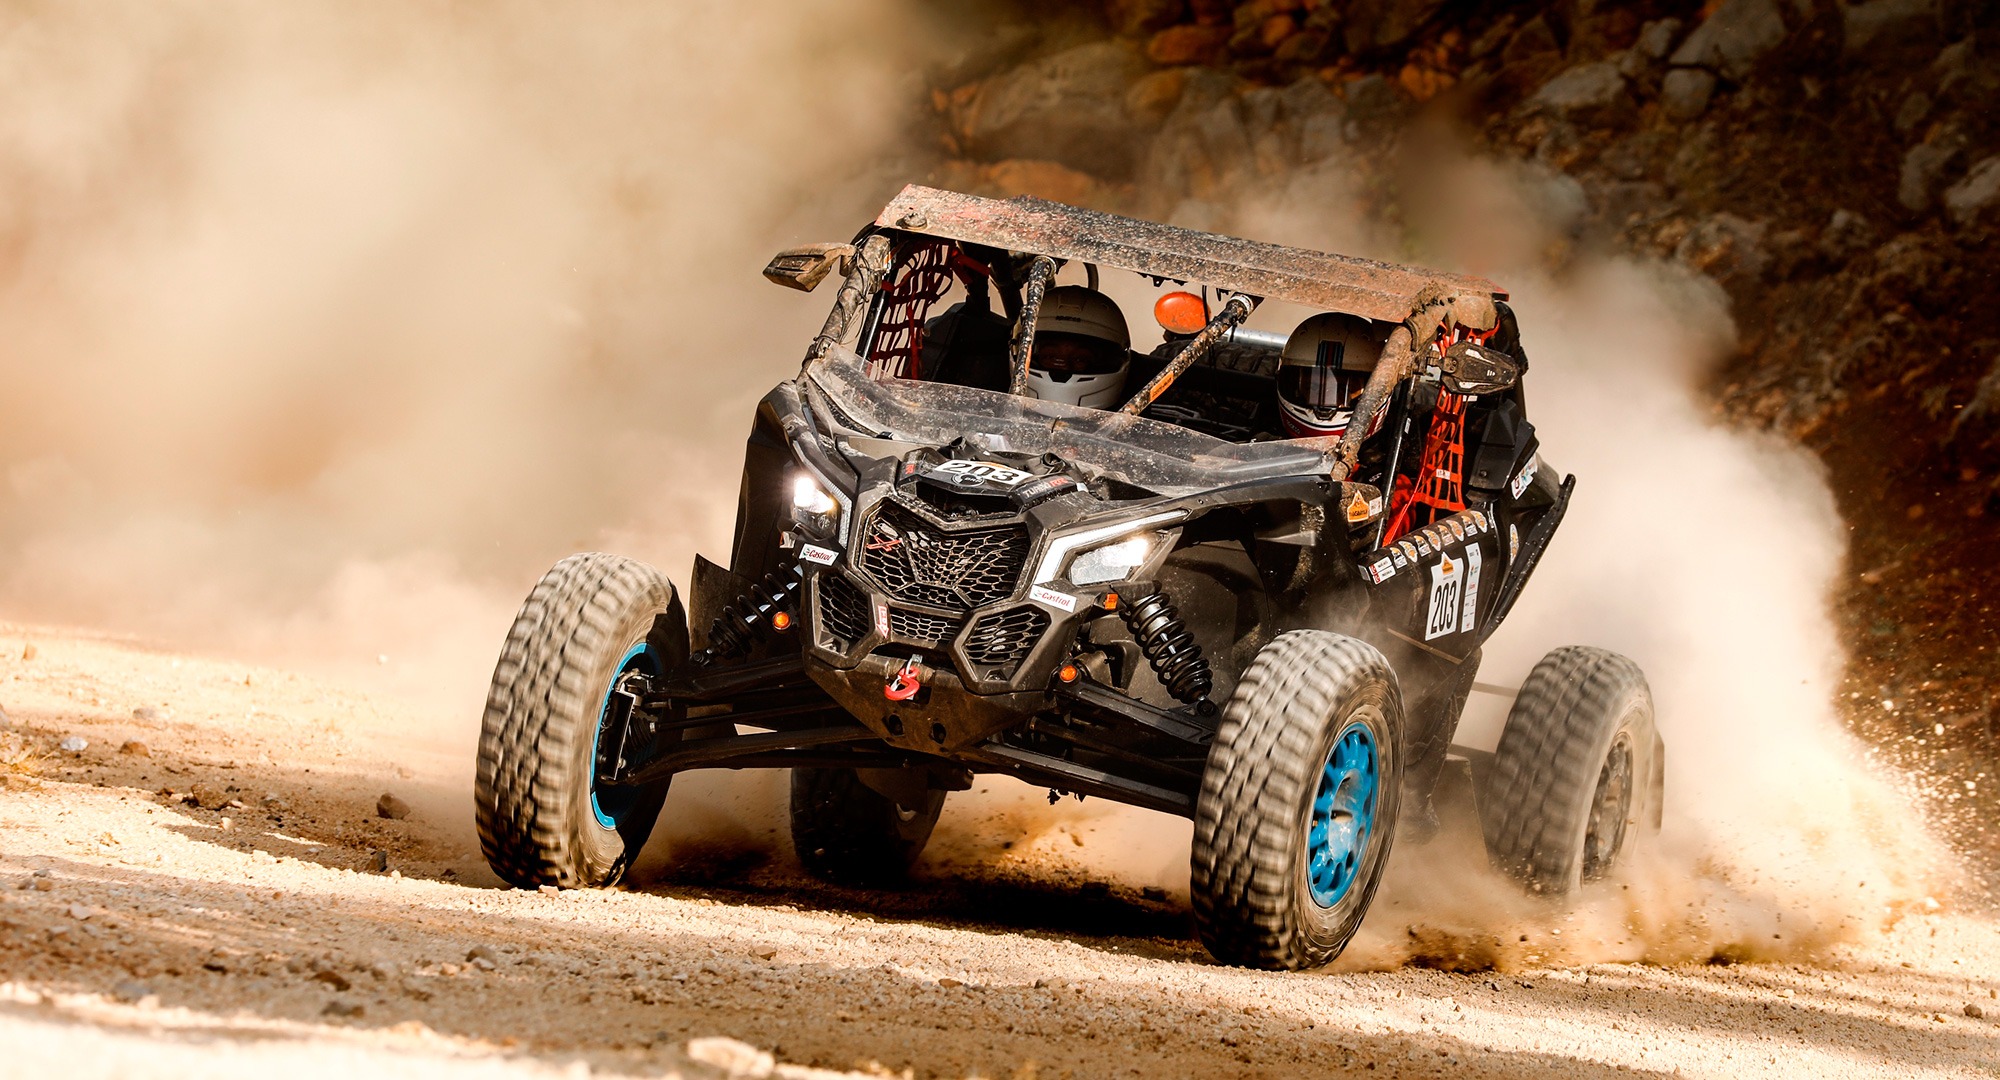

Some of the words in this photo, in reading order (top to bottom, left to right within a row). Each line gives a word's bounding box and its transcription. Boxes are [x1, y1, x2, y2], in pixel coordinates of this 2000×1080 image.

[943, 462, 1019, 482] 203
[808, 549, 833, 561] Castrol
[1041, 591, 1071, 607] Castrol
[1430, 579, 1457, 635] 203
